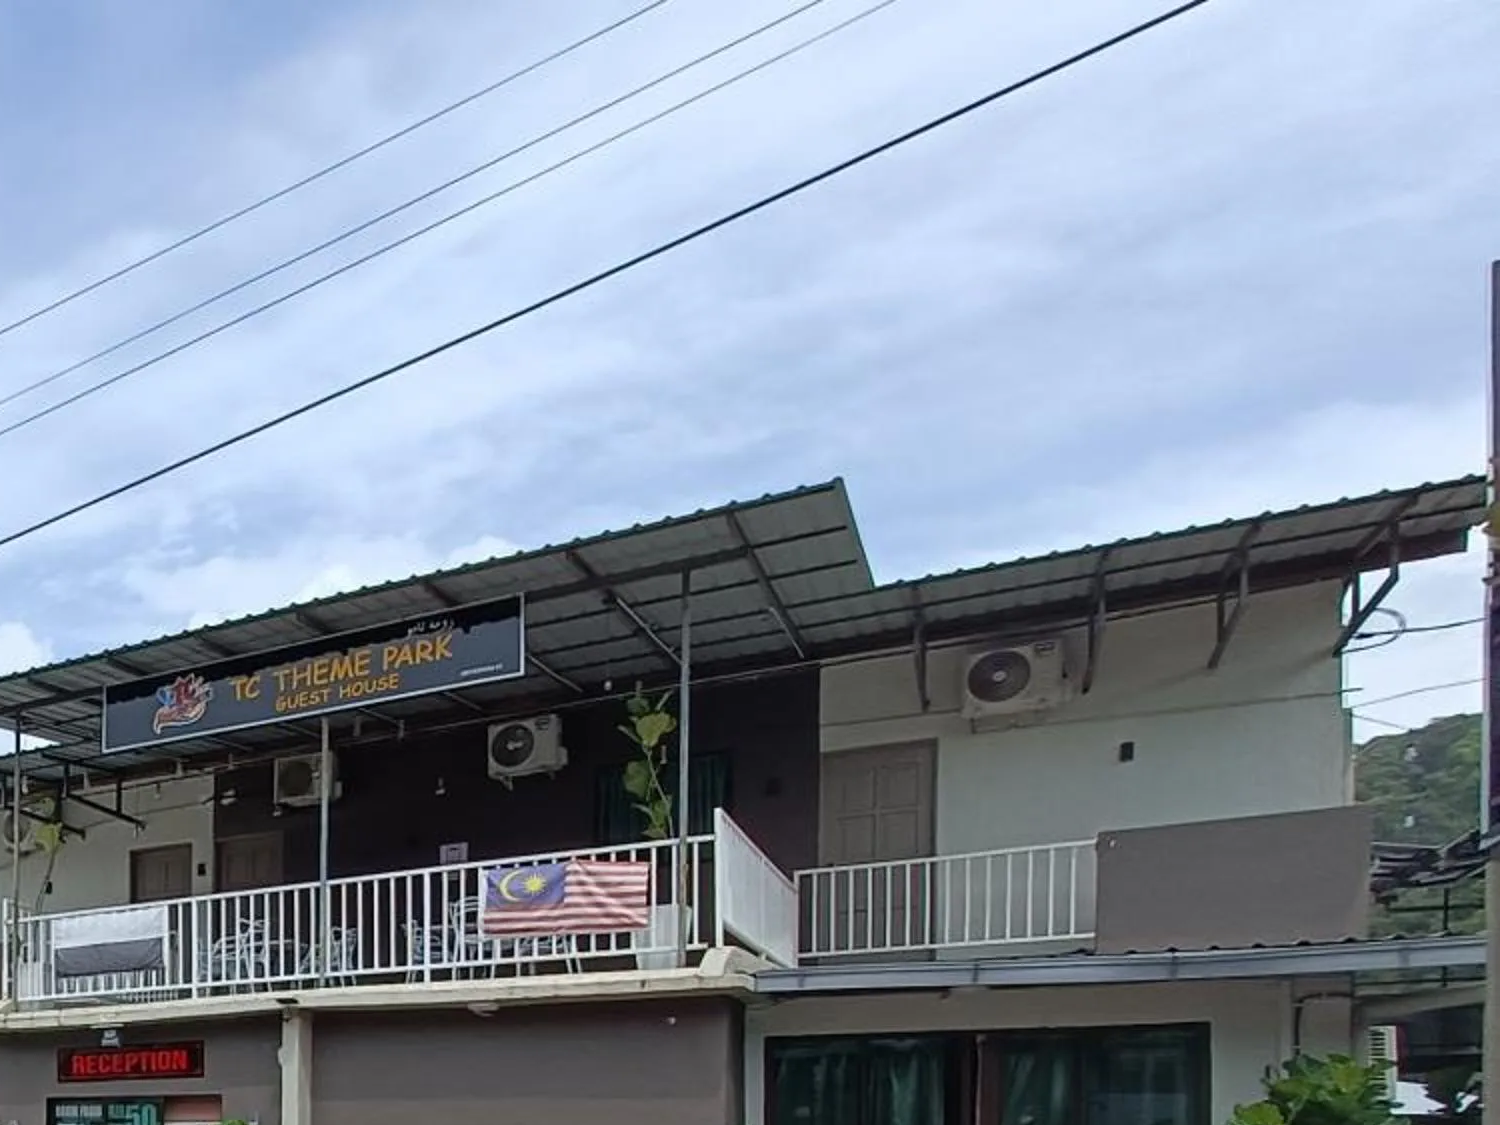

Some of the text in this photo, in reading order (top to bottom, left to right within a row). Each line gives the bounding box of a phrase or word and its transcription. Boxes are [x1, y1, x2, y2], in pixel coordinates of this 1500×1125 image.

[227, 633, 453, 700] TC THEME PARK
[275, 673, 400, 712] GUEST HOUSE
[71, 1050, 188, 1075] RECEPTION
